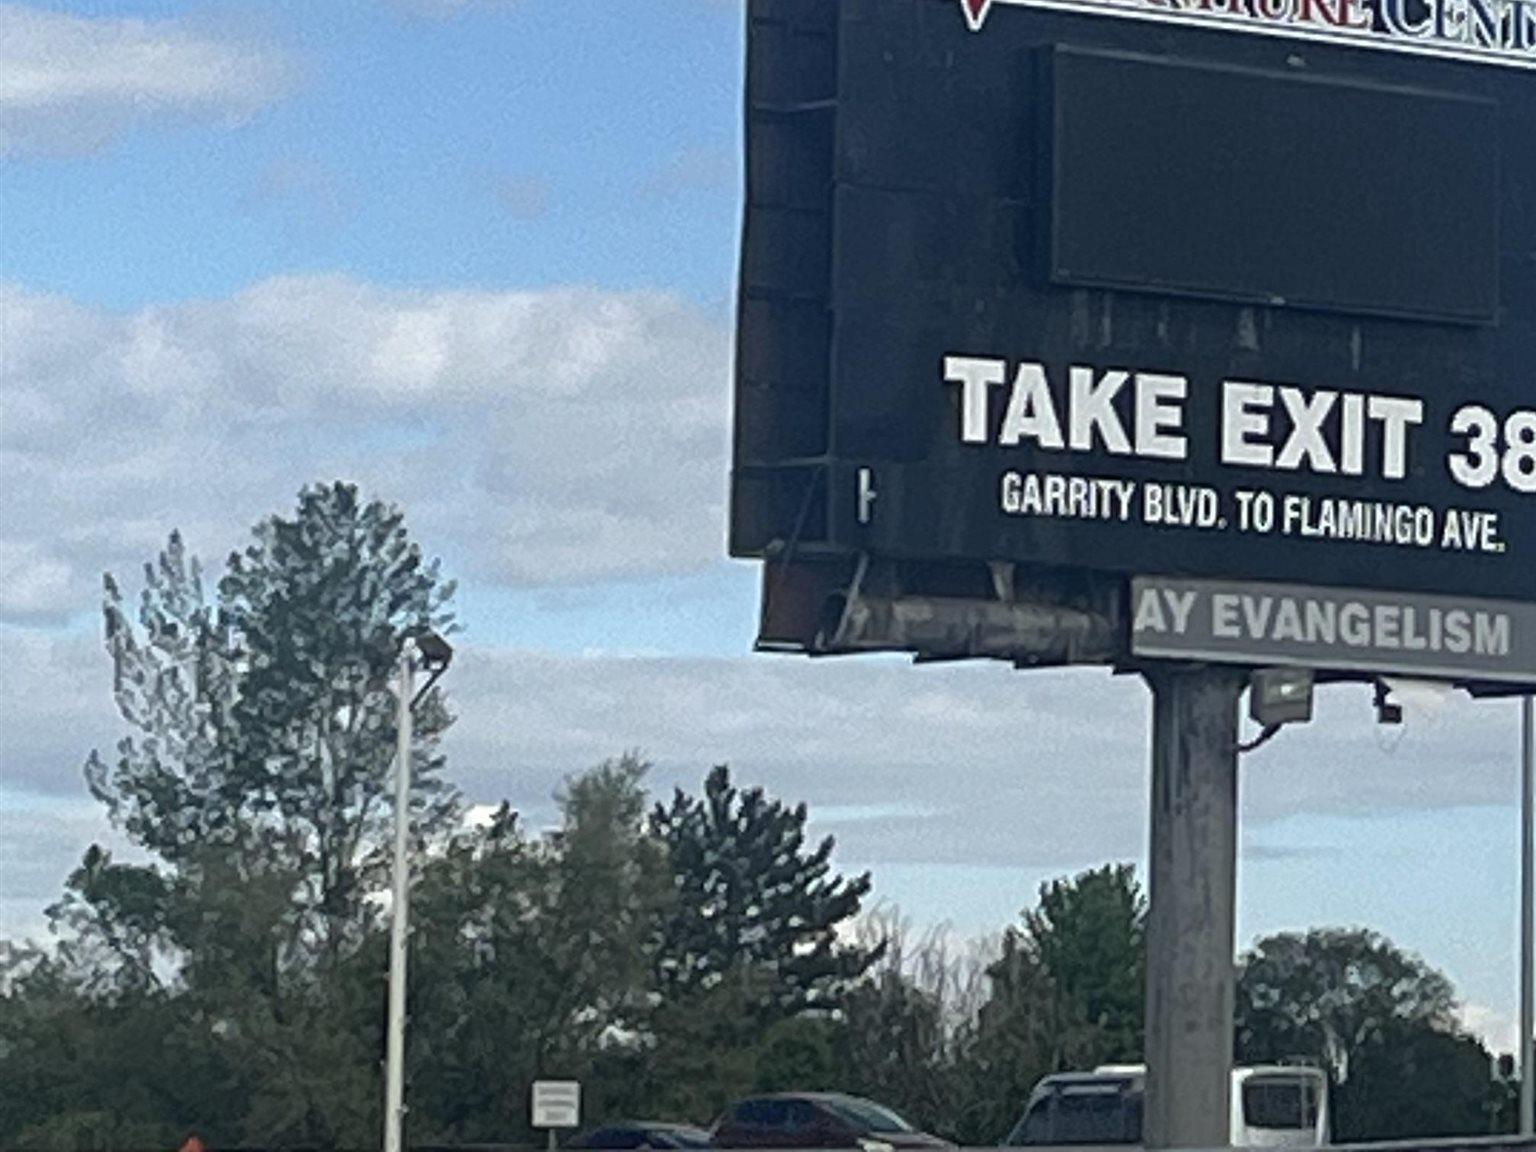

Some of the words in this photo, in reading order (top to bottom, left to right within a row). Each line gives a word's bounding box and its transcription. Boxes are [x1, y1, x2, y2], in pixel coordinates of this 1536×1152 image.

[944, 356, 1188, 460] TAKE
[1220, 381, 1423, 478] EXIT
[1001, 472, 1136, 522] GARRITY
[1143, 486, 1228, 530] BLVD.
[1235, 491, 1275, 535] TO
[1282, 496, 1434, 547] FLAMINGO
[1440, 510, 1506, 554] AVE.
[1133, 588, 1197, 634] AY
[1211, 593, 1509, 655] EVANGELISM
